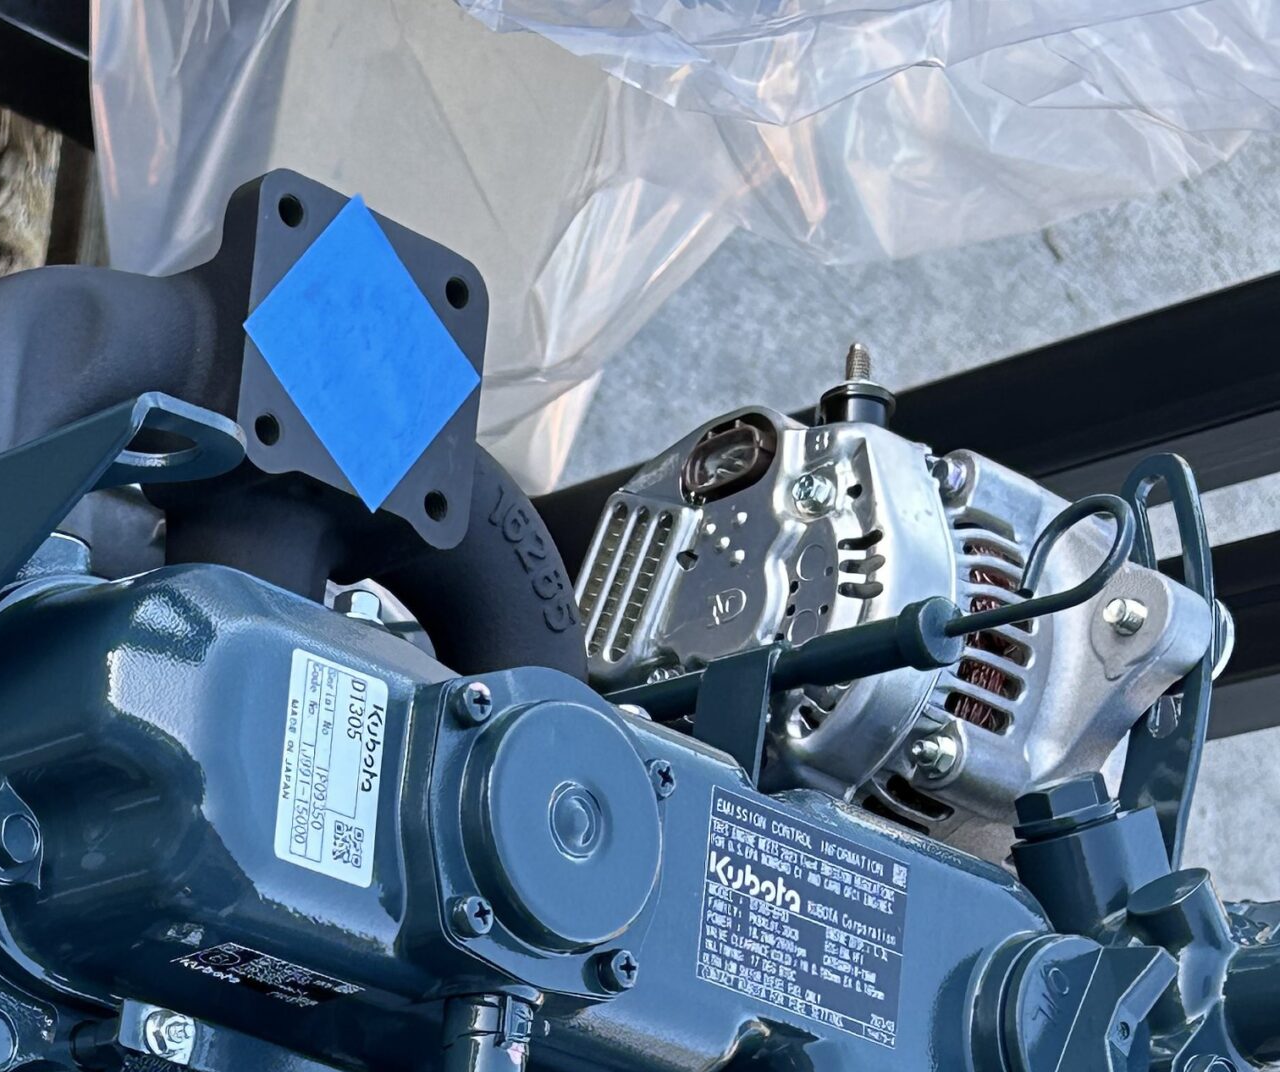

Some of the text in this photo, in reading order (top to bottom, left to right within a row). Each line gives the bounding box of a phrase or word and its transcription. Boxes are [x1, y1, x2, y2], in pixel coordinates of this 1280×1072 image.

[347, 680, 365, 741] D1305
[361, 704, 383, 792] Kubota
[282, 759, 292, 799] JAPAN
[716, 798, 767, 830] EMISSION
[771, 819, 812, 850] CONTROL
[821, 840, 884, 877] INFORMATION
[709, 851, 801, 913] Kubota
[841, 914, 896, 946] Corporation
